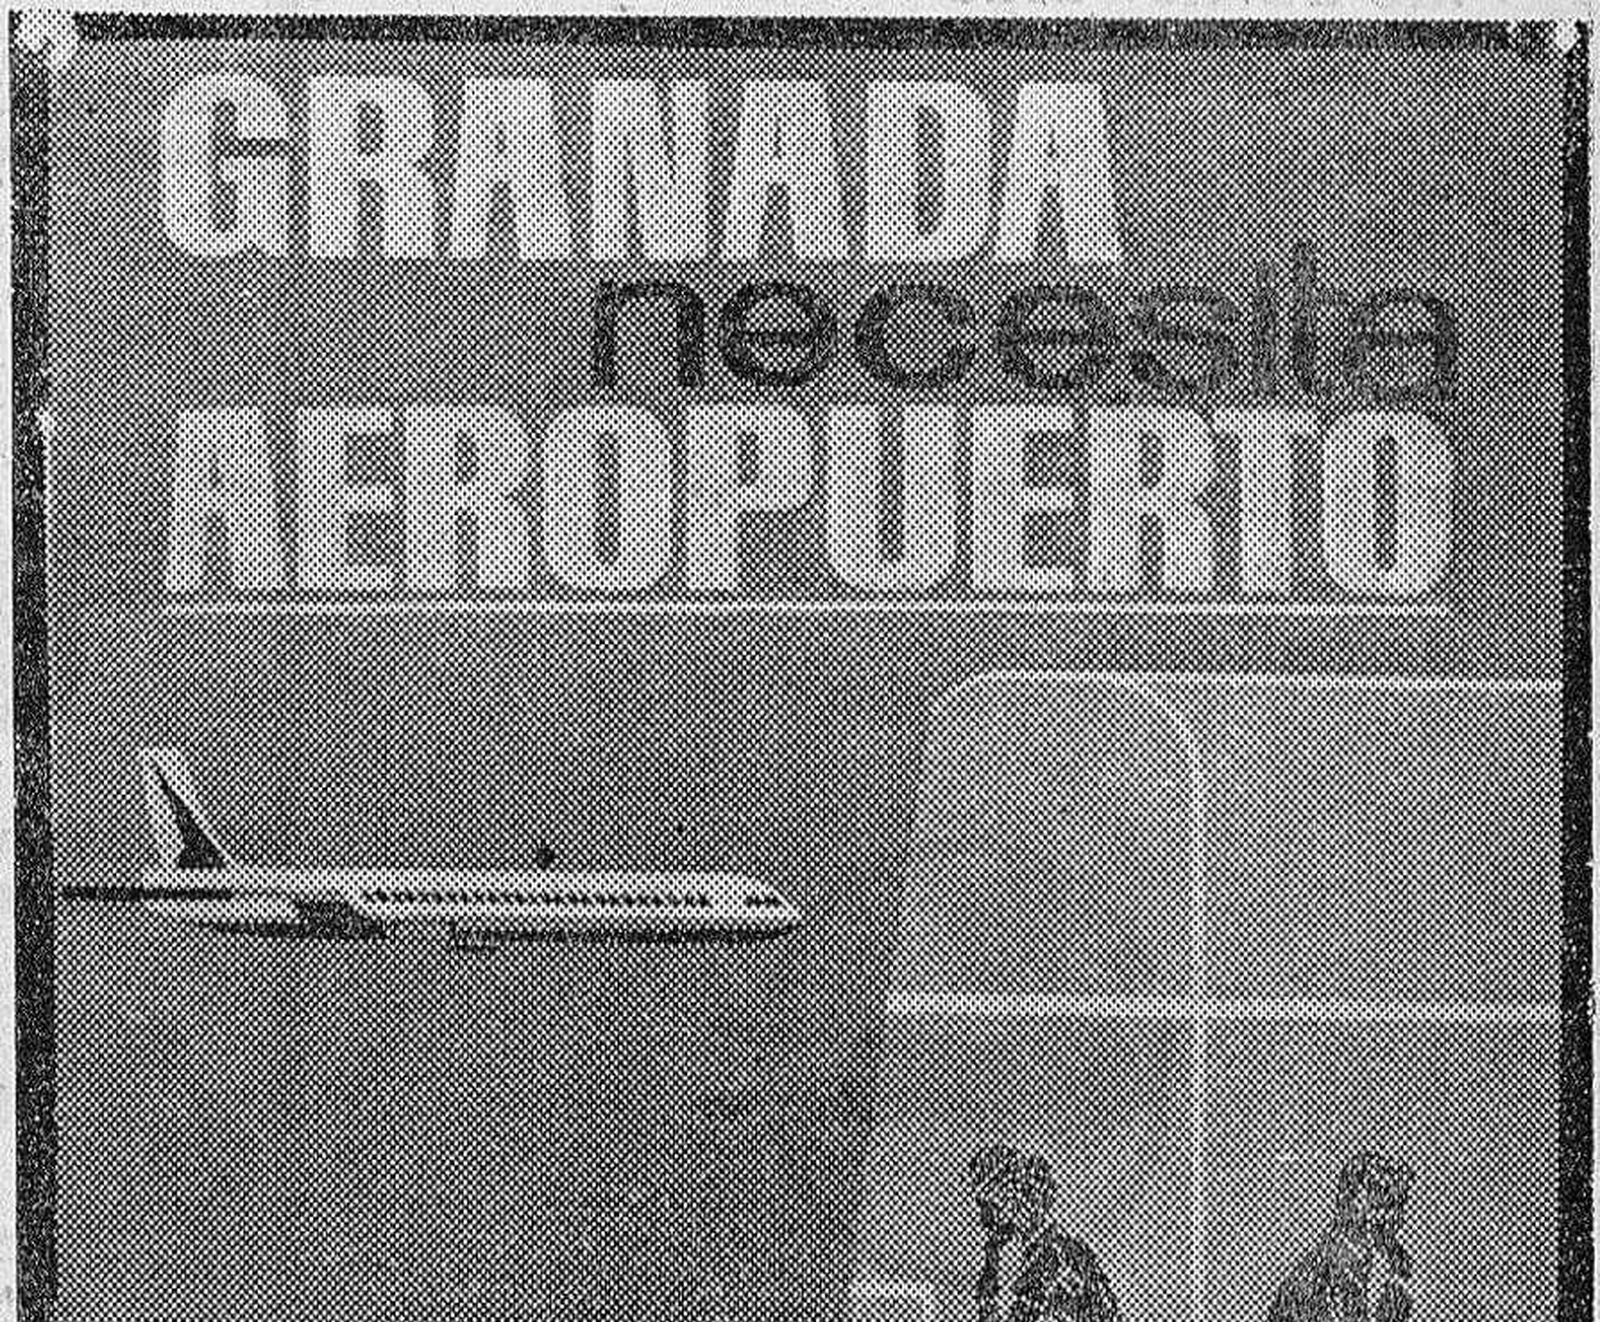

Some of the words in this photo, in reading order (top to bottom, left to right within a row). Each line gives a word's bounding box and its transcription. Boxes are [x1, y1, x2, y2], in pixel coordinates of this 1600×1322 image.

[160, 73, 1122, 264] GRANADA
[590, 241, 1460, 400] necesita
[163, 405, 1456, 594] AEROPUERTO
